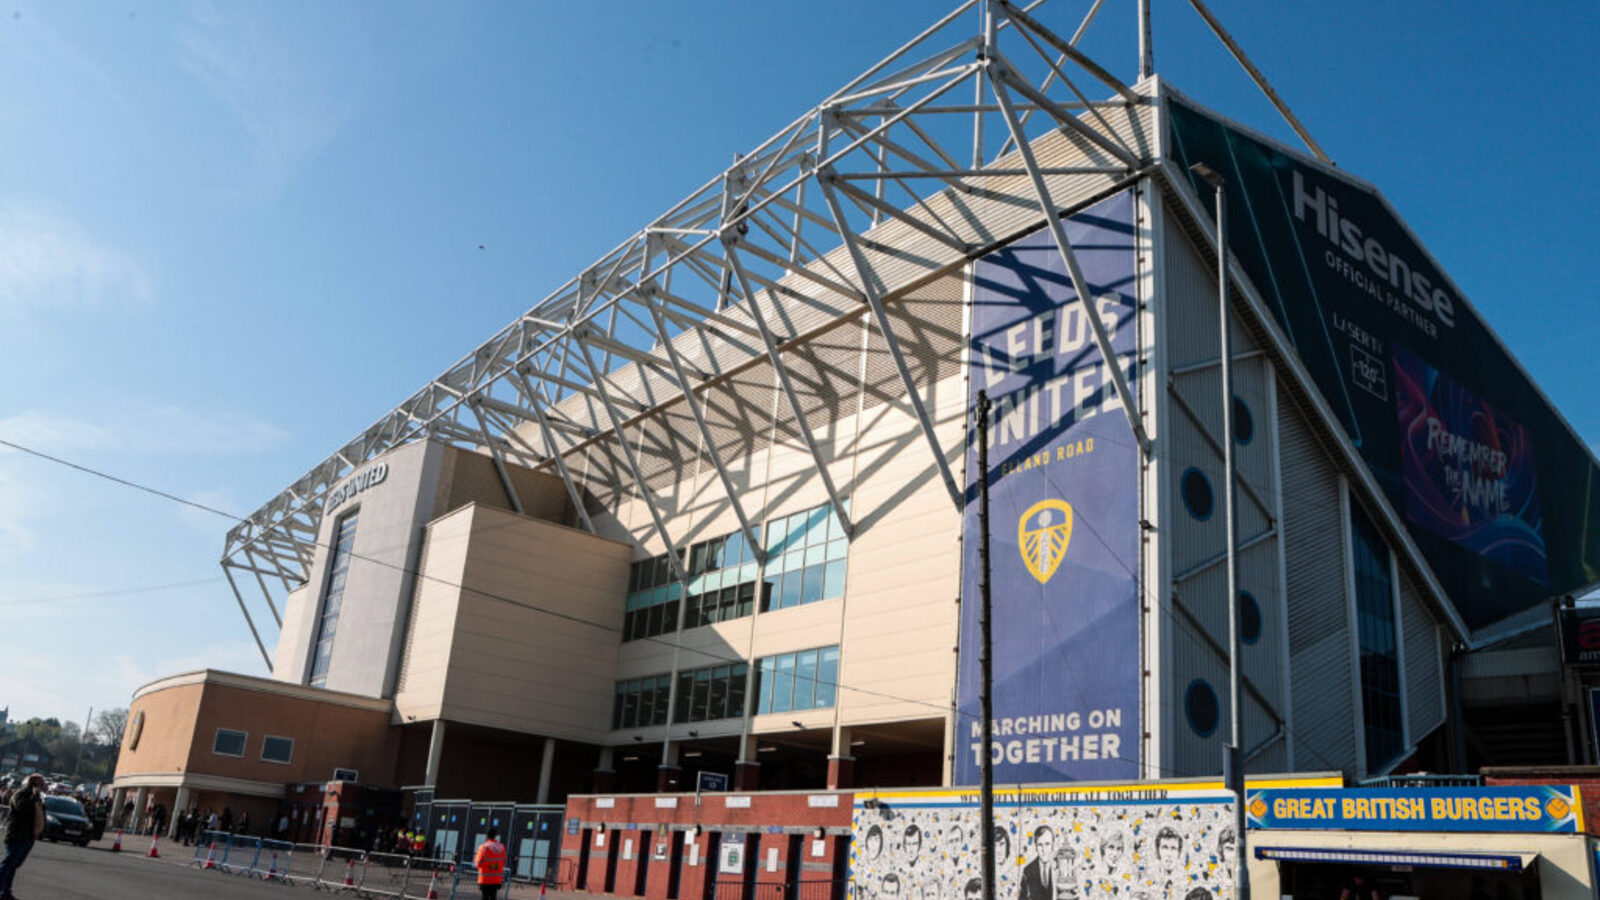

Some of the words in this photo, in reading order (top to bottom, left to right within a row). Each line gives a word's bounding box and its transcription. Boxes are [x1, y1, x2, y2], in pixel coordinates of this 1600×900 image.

[1293, 169, 1455, 328] Hisense
[1325, 251, 1384, 303] OFFICIAL
[1386, 291, 1438, 340] PARTNER
[982, 292, 1122, 390] LEEDS
[973, 354, 1134, 453] UNITED
[1001, 451, 1051, 477] ELLAND
[1056, 438, 1095, 462] ROAD
[1463, 469, 1511, 513] NAME
[971, 711, 1081, 738] MARCHING
[1088, 708, 1122, 728] ON
[971, 733, 1121, 766] TOGETHER
[1105, 788, 1169, 802] TOGETHER
[1273, 798, 1337, 820] GREAT
[1342, 797, 1426, 820] BRITISH
[1431, 797, 1543, 821] BURGERS
